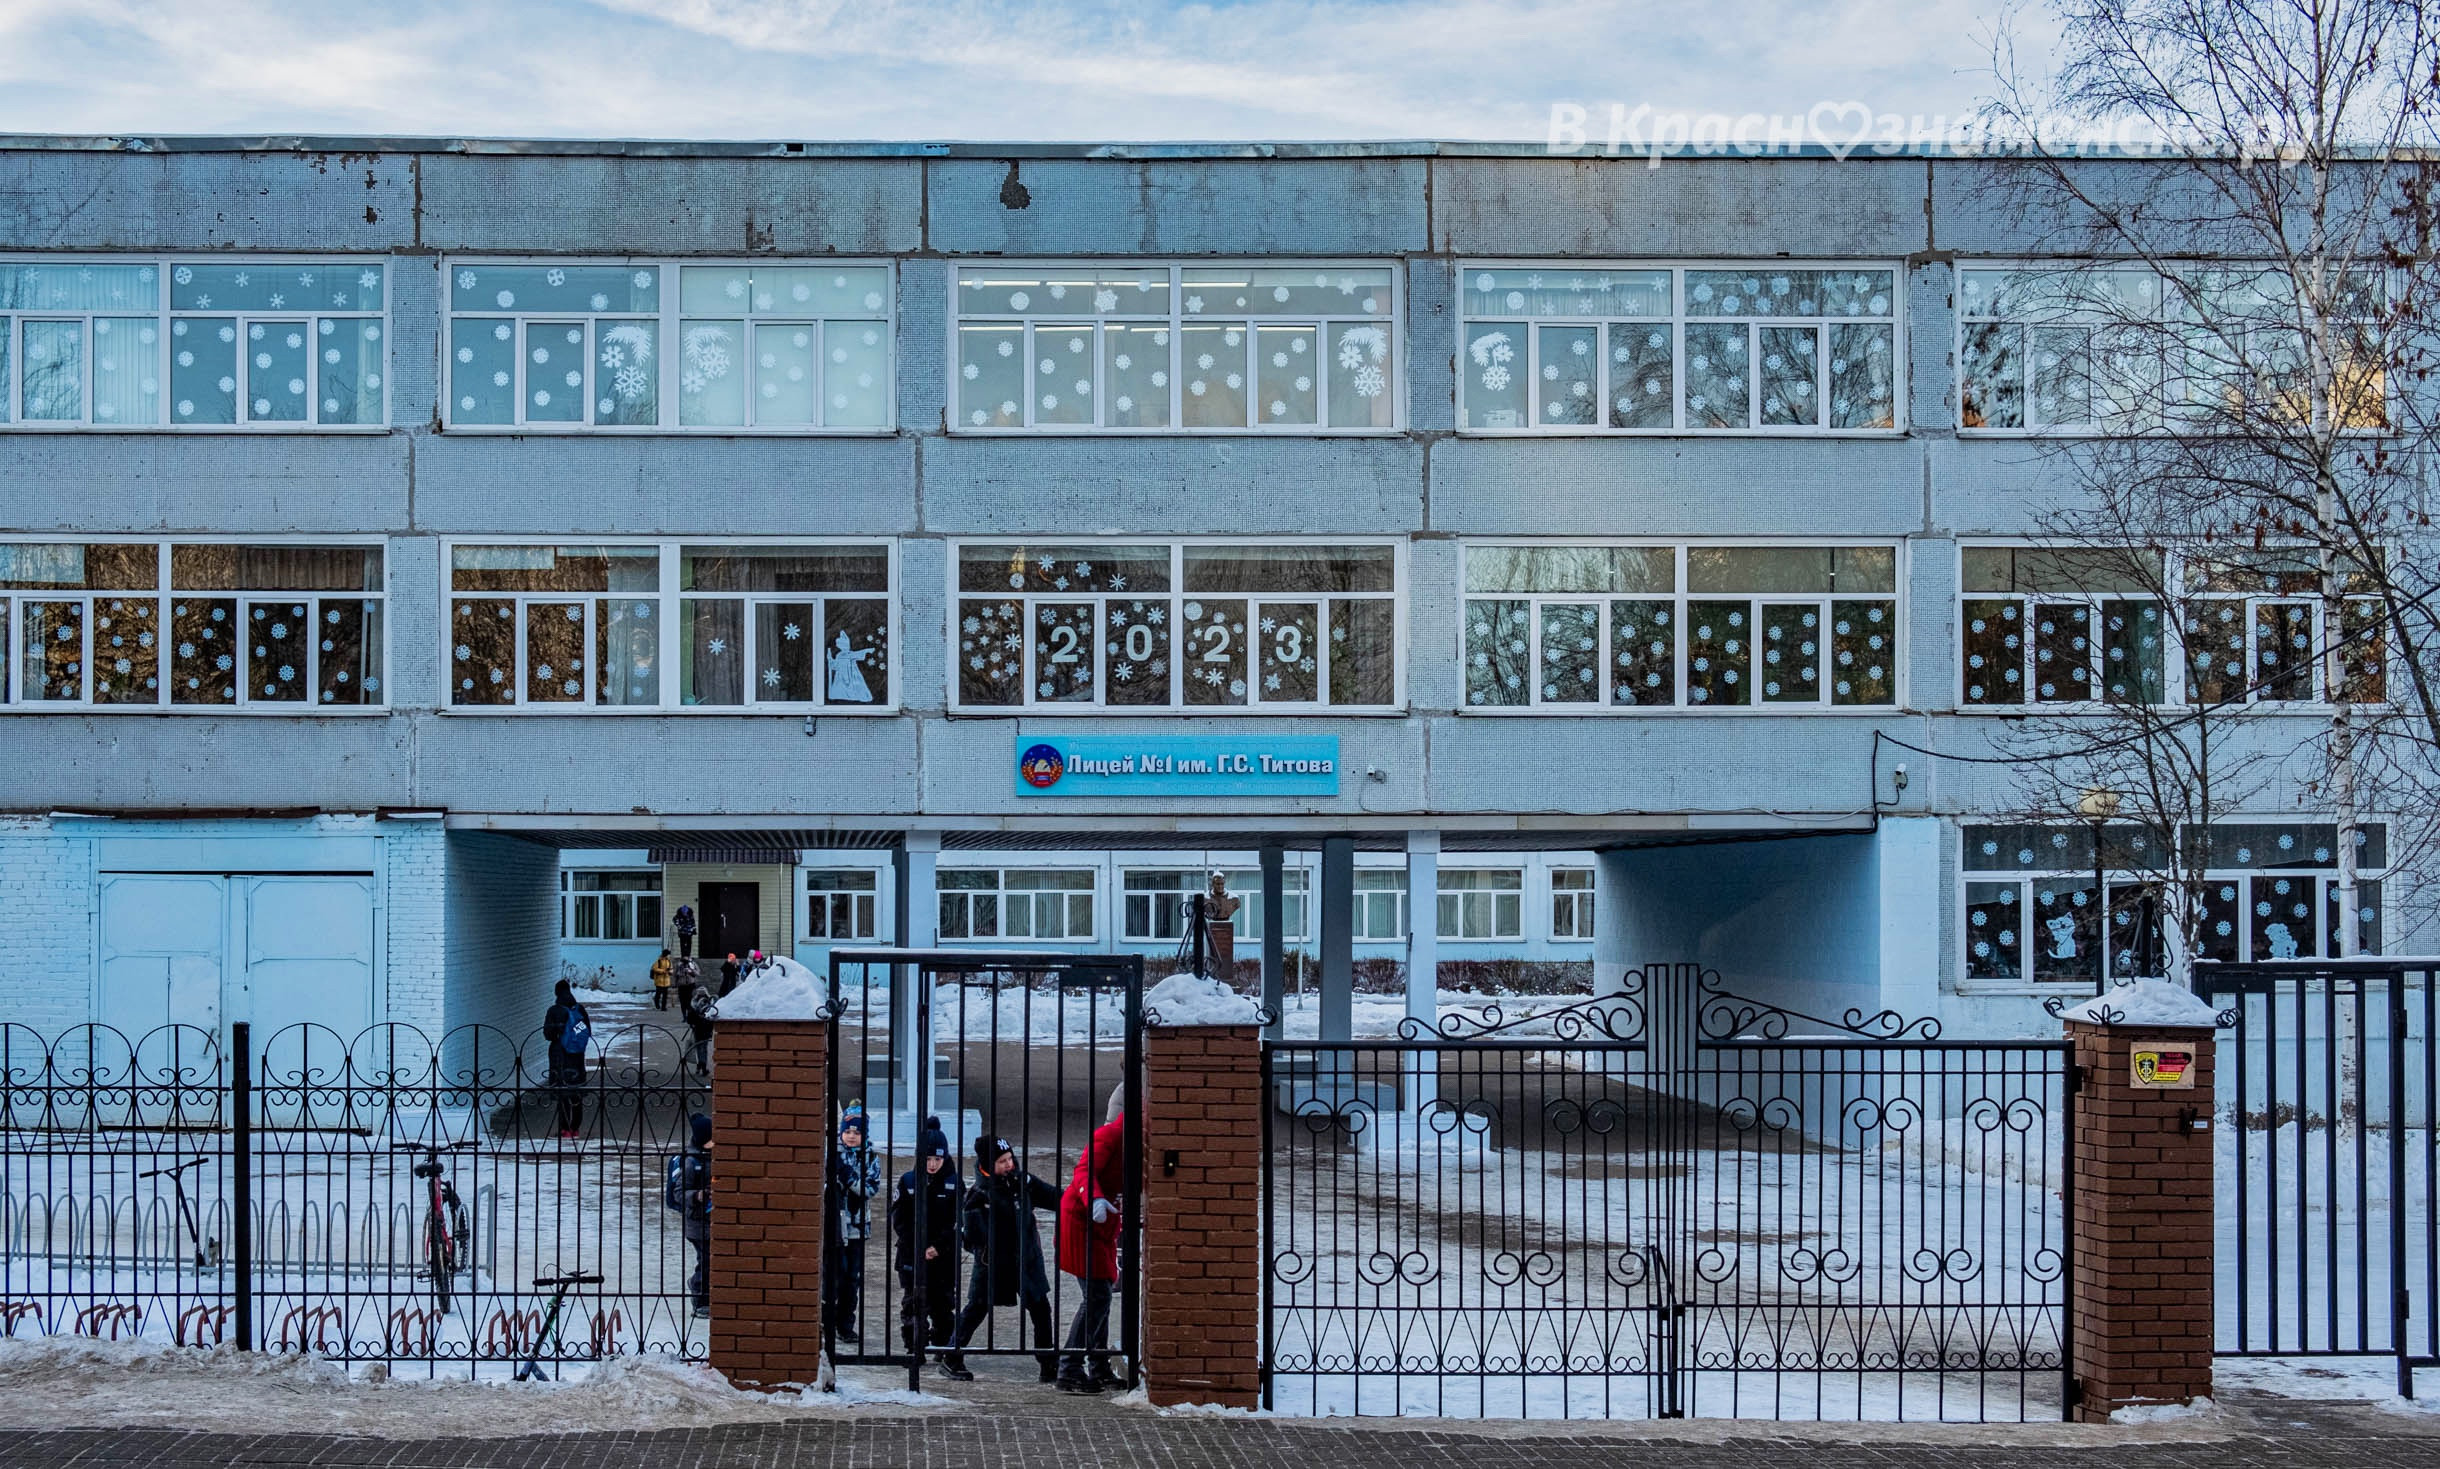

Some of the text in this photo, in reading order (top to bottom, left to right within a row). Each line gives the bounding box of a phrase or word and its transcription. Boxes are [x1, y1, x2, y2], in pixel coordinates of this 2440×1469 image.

[1051, 625, 1301, 662] 2023
[1067, 754, 1134, 776] Лицей
[1177, 759, 1211, 773] им.
[1259, 754, 1333, 773] Титова
